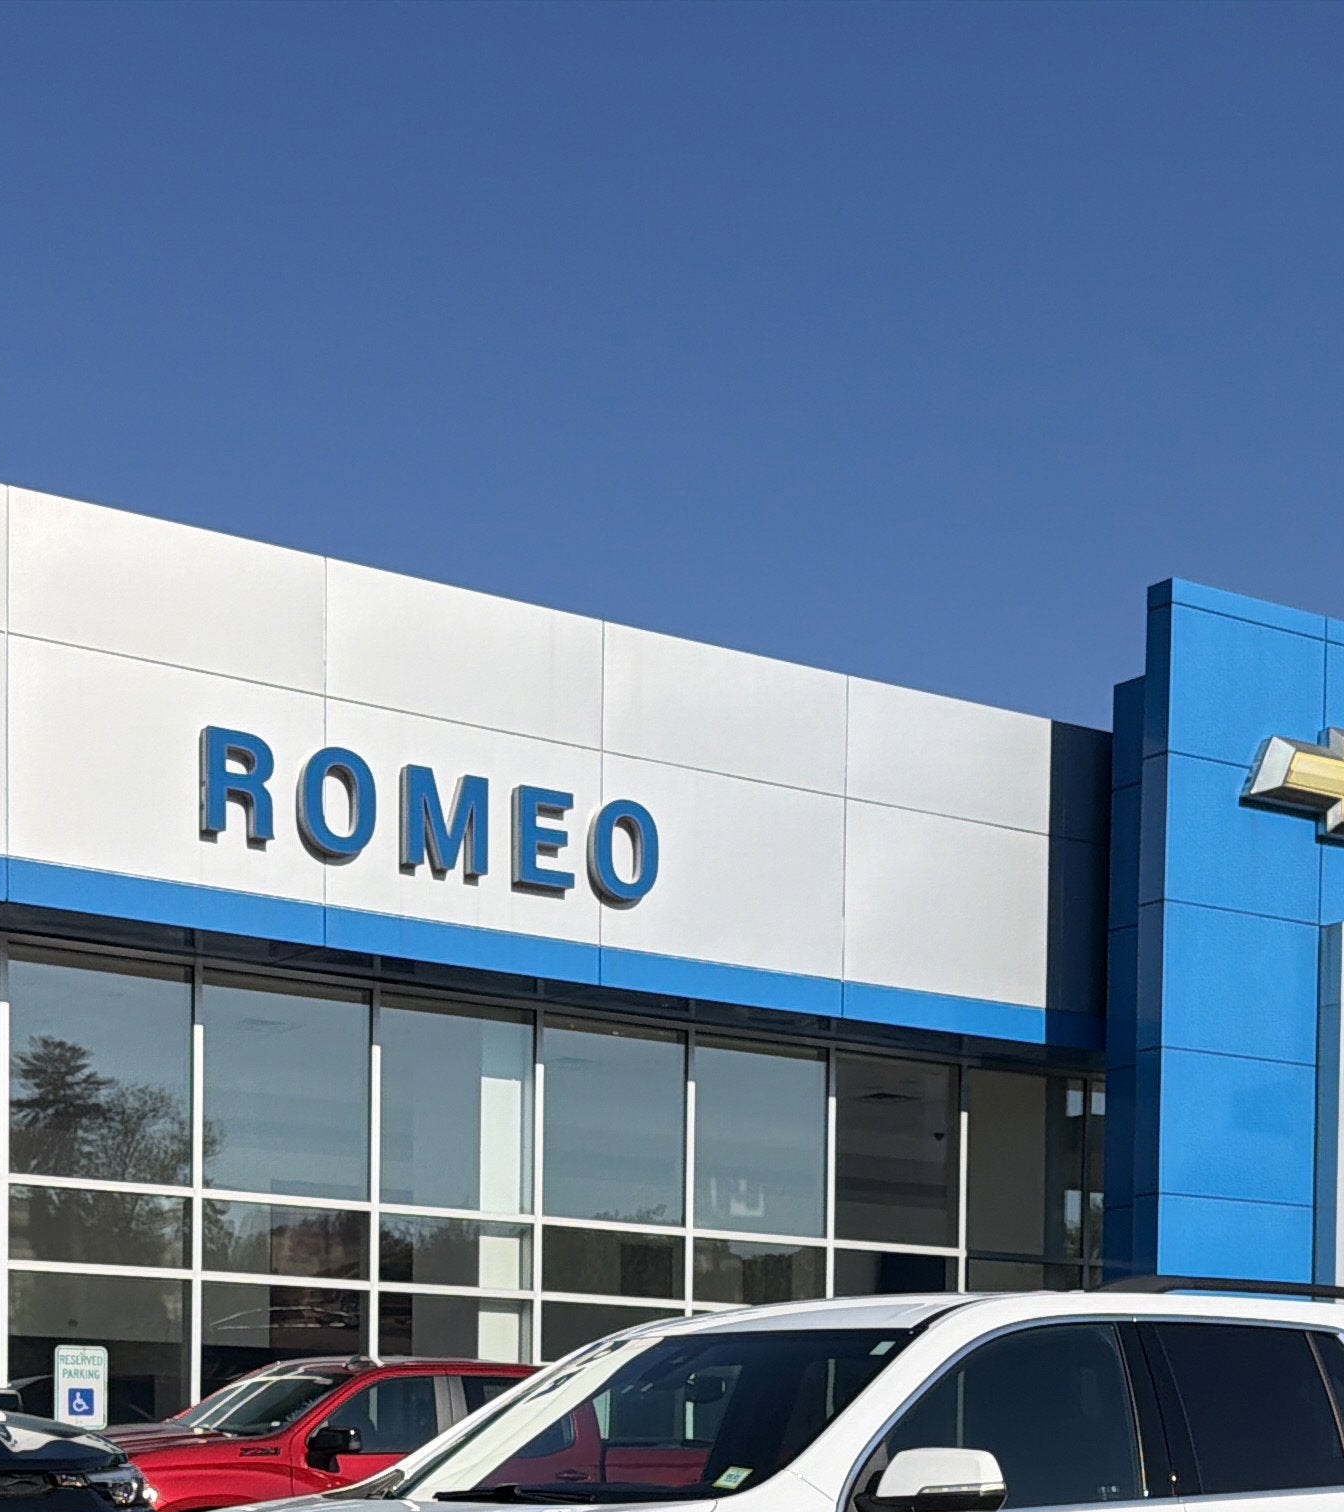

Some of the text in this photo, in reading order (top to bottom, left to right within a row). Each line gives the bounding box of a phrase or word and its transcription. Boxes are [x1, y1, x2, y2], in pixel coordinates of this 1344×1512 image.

[199, 725, 658, 910] ROMEO
[59, 1354, 103, 1366] RESERVED
[62, 1368, 100, 1379] PARKING
